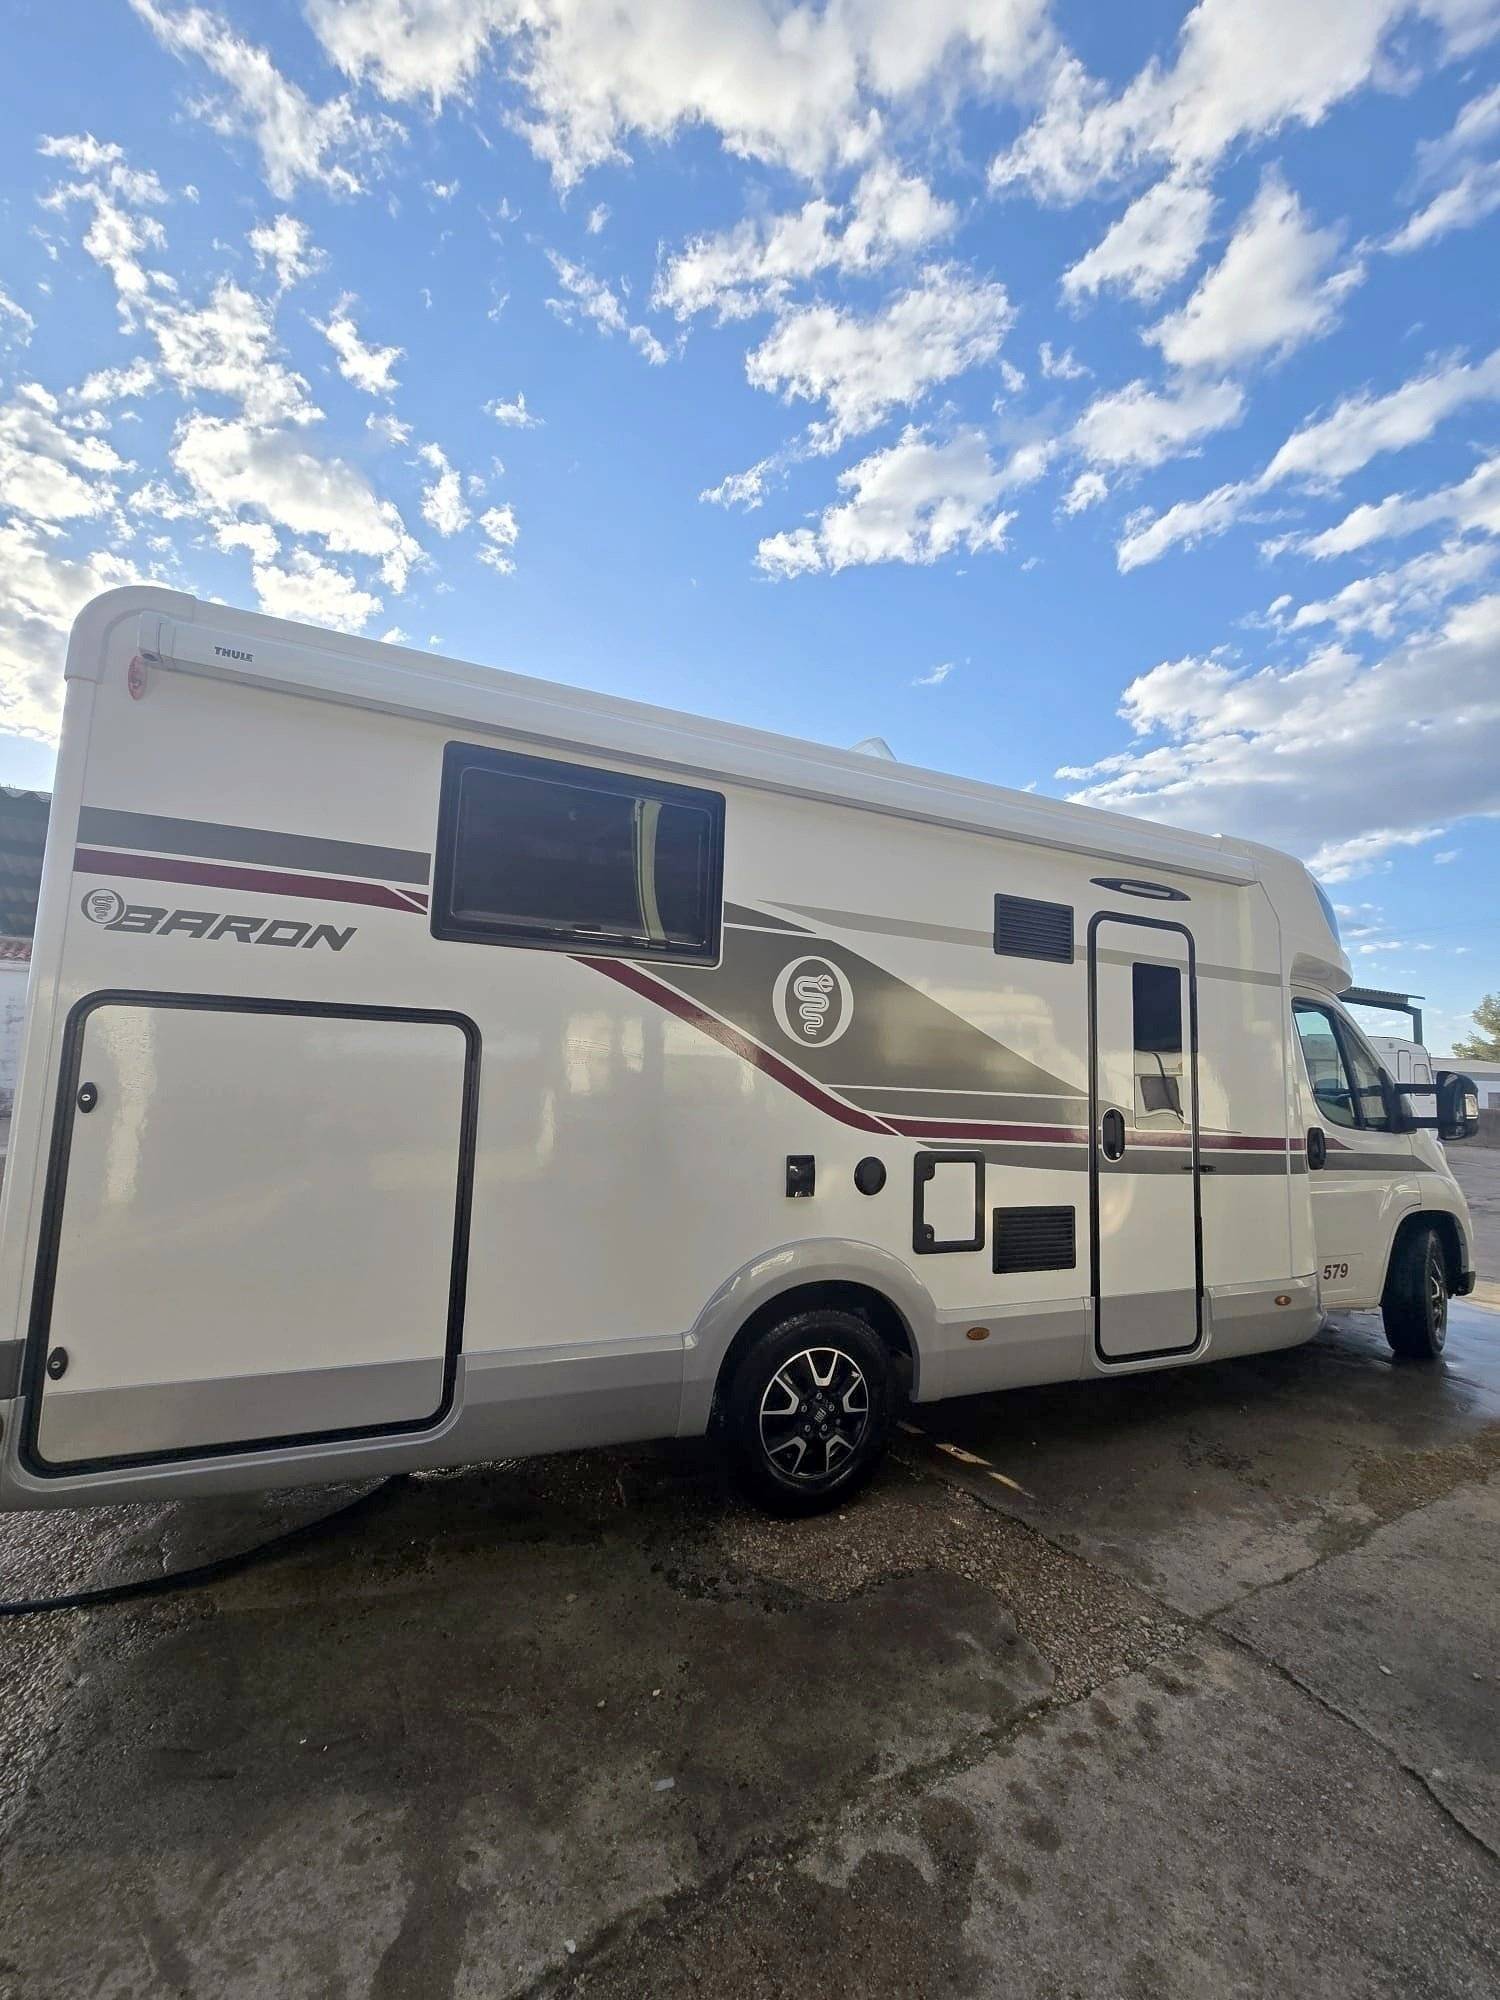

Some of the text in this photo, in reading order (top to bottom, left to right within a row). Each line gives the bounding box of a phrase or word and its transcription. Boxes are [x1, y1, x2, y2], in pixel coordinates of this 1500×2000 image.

[214, 646, 254, 663] THULE
[103, 904, 358, 952] BARON
[1323, 1263, 1348, 1280] 579
